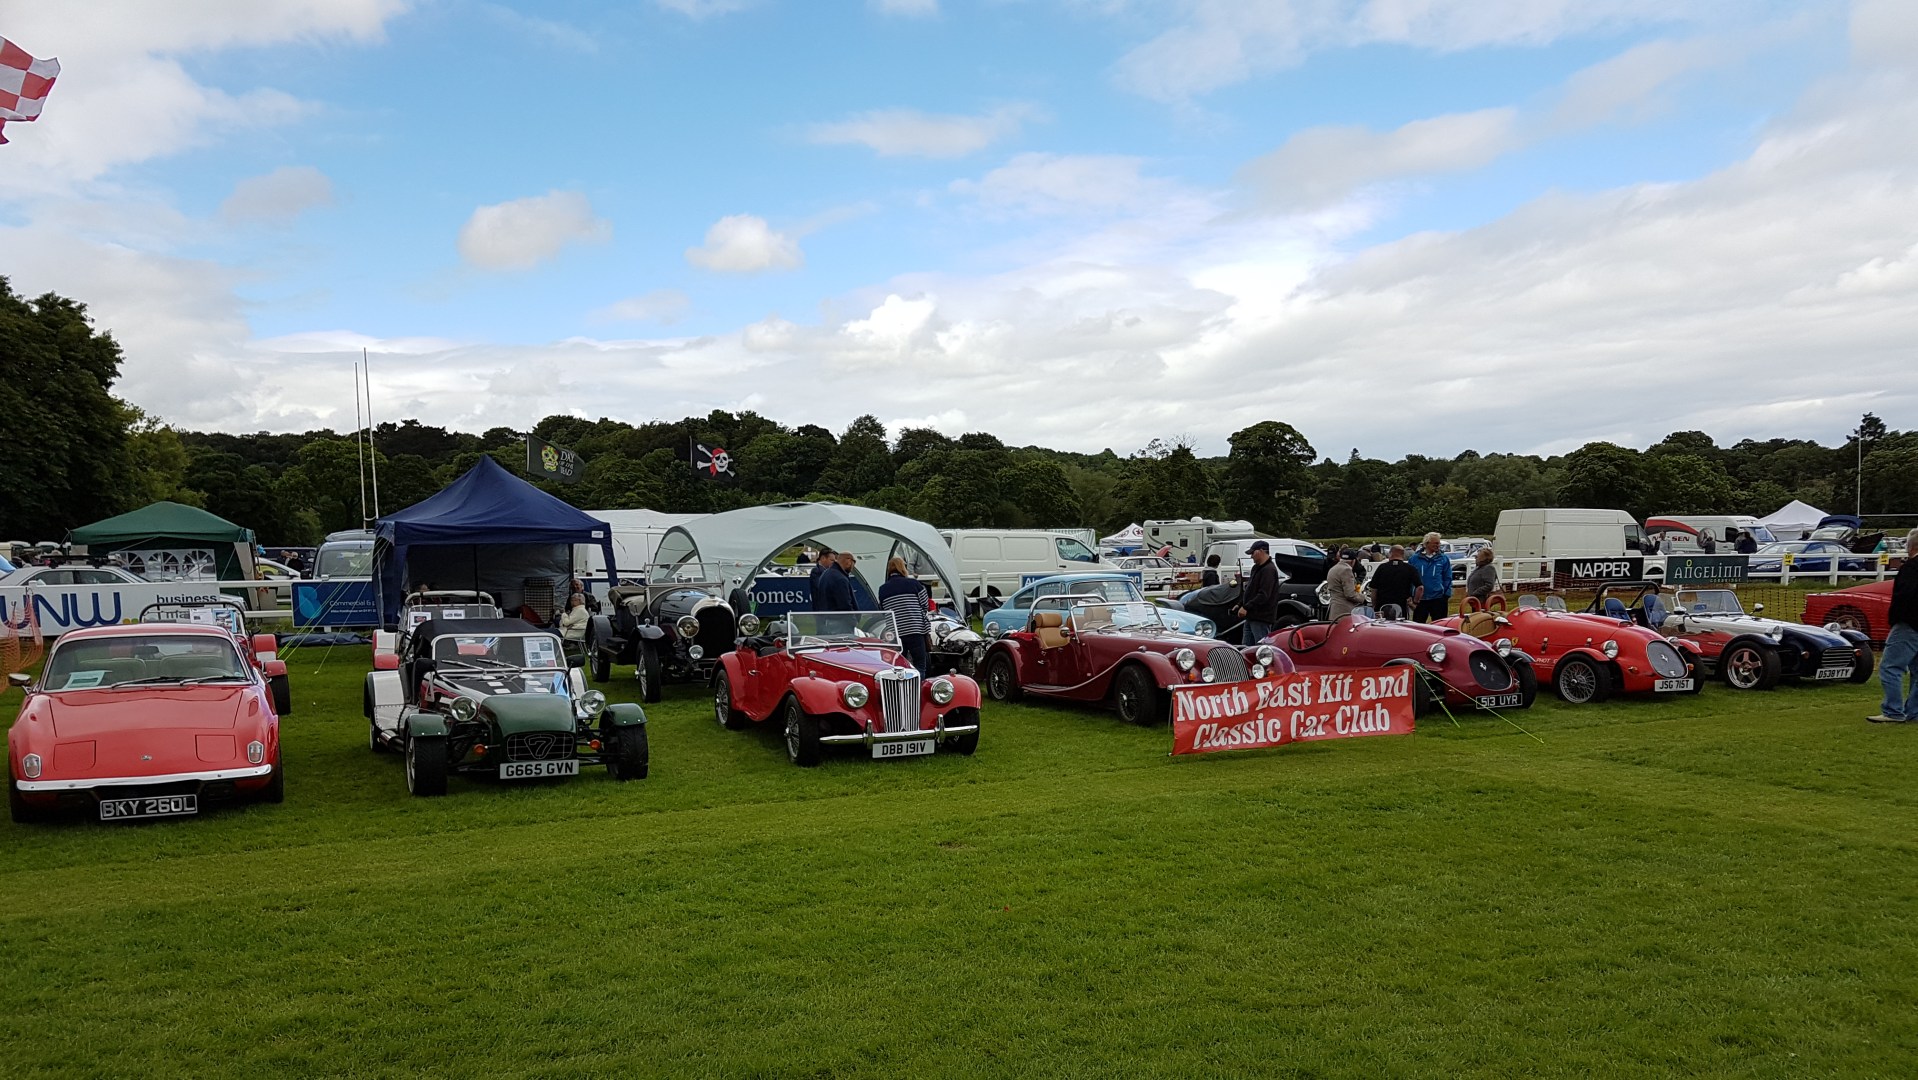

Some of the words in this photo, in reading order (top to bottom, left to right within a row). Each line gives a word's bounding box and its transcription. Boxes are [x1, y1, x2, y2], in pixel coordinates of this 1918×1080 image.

[560, 451, 575, 463] DAY
[1572, 562, 1631, 578] NAPPER
[156, 594, 218, 604] business
[0, 592, 122, 629] UNW
[1659, 680, 1674, 689] JSG
[1176, 686, 1249, 721] North
[1255, 677, 1312, 711] East
[1318, 673, 1353, 703] Kit
[1360, 669, 1409, 700] and
[1481, 696, 1496, 706] 513
[1499, 694, 1518, 705] UYR
[1193, 713, 1282, 749] Classic
[1290, 710, 1330, 739] Car
[1335, 703, 1390, 735] Club
[528, 736, 553, 757] 7
[882, 744, 904, 756] DBB
[906, 742, 926, 753] 191V
[506, 763, 542, 777] G665
[546, 761, 573, 774] GVN
[102, 800, 140, 817] BKY
[145, 797, 196, 813] 260L
